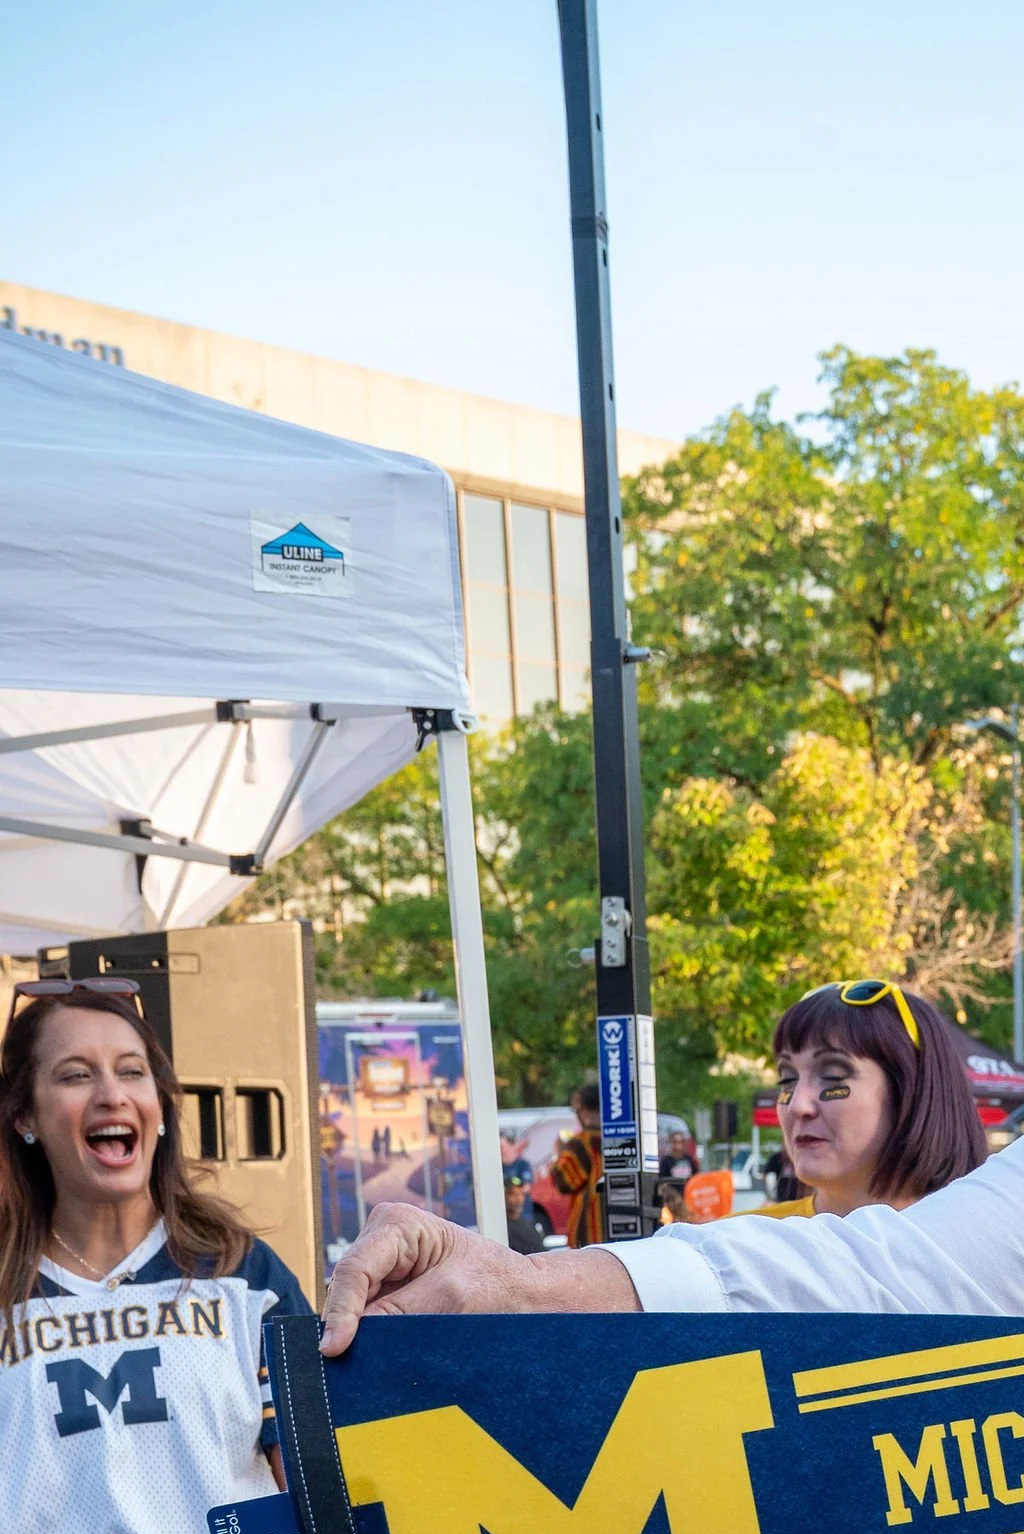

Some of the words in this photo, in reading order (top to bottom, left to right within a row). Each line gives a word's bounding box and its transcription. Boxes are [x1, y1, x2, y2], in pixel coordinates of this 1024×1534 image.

[283, 545, 322, 560] ULINE
[269, 562, 301, 572] INSTANT
[303, 564, 337, 576] CANOPY
[45, 1346, 169, 1438] M
[215, 1518, 225, 1527] it
